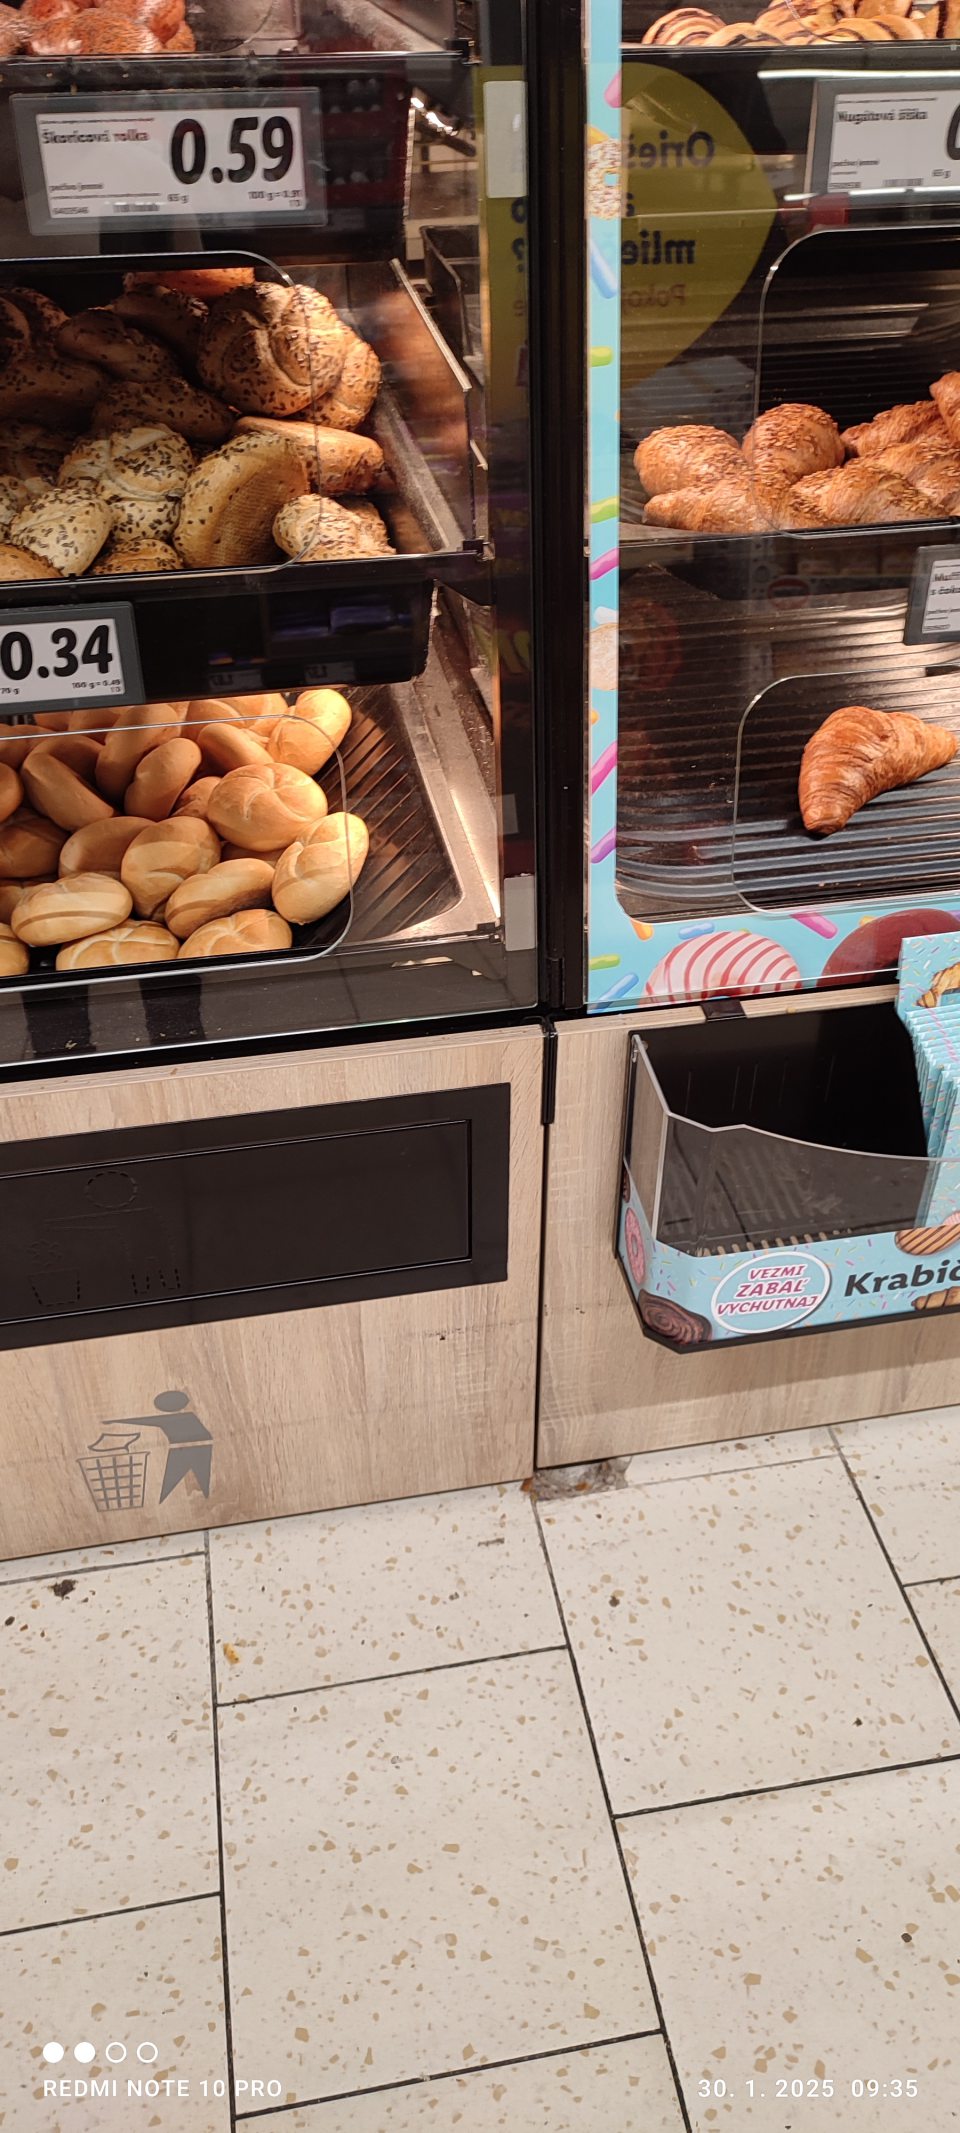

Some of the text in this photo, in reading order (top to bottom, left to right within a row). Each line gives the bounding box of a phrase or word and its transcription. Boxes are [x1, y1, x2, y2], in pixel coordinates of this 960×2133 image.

[171, 115, 295, 185] 0.59
[0, 624, 113, 681] 0.34
[748, 1264, 805, 1281] VEZMI
[735, 1278, 809, 1298] ZABAĽ
[716, 1294, 819, 1316] VYCHUTNAJ
